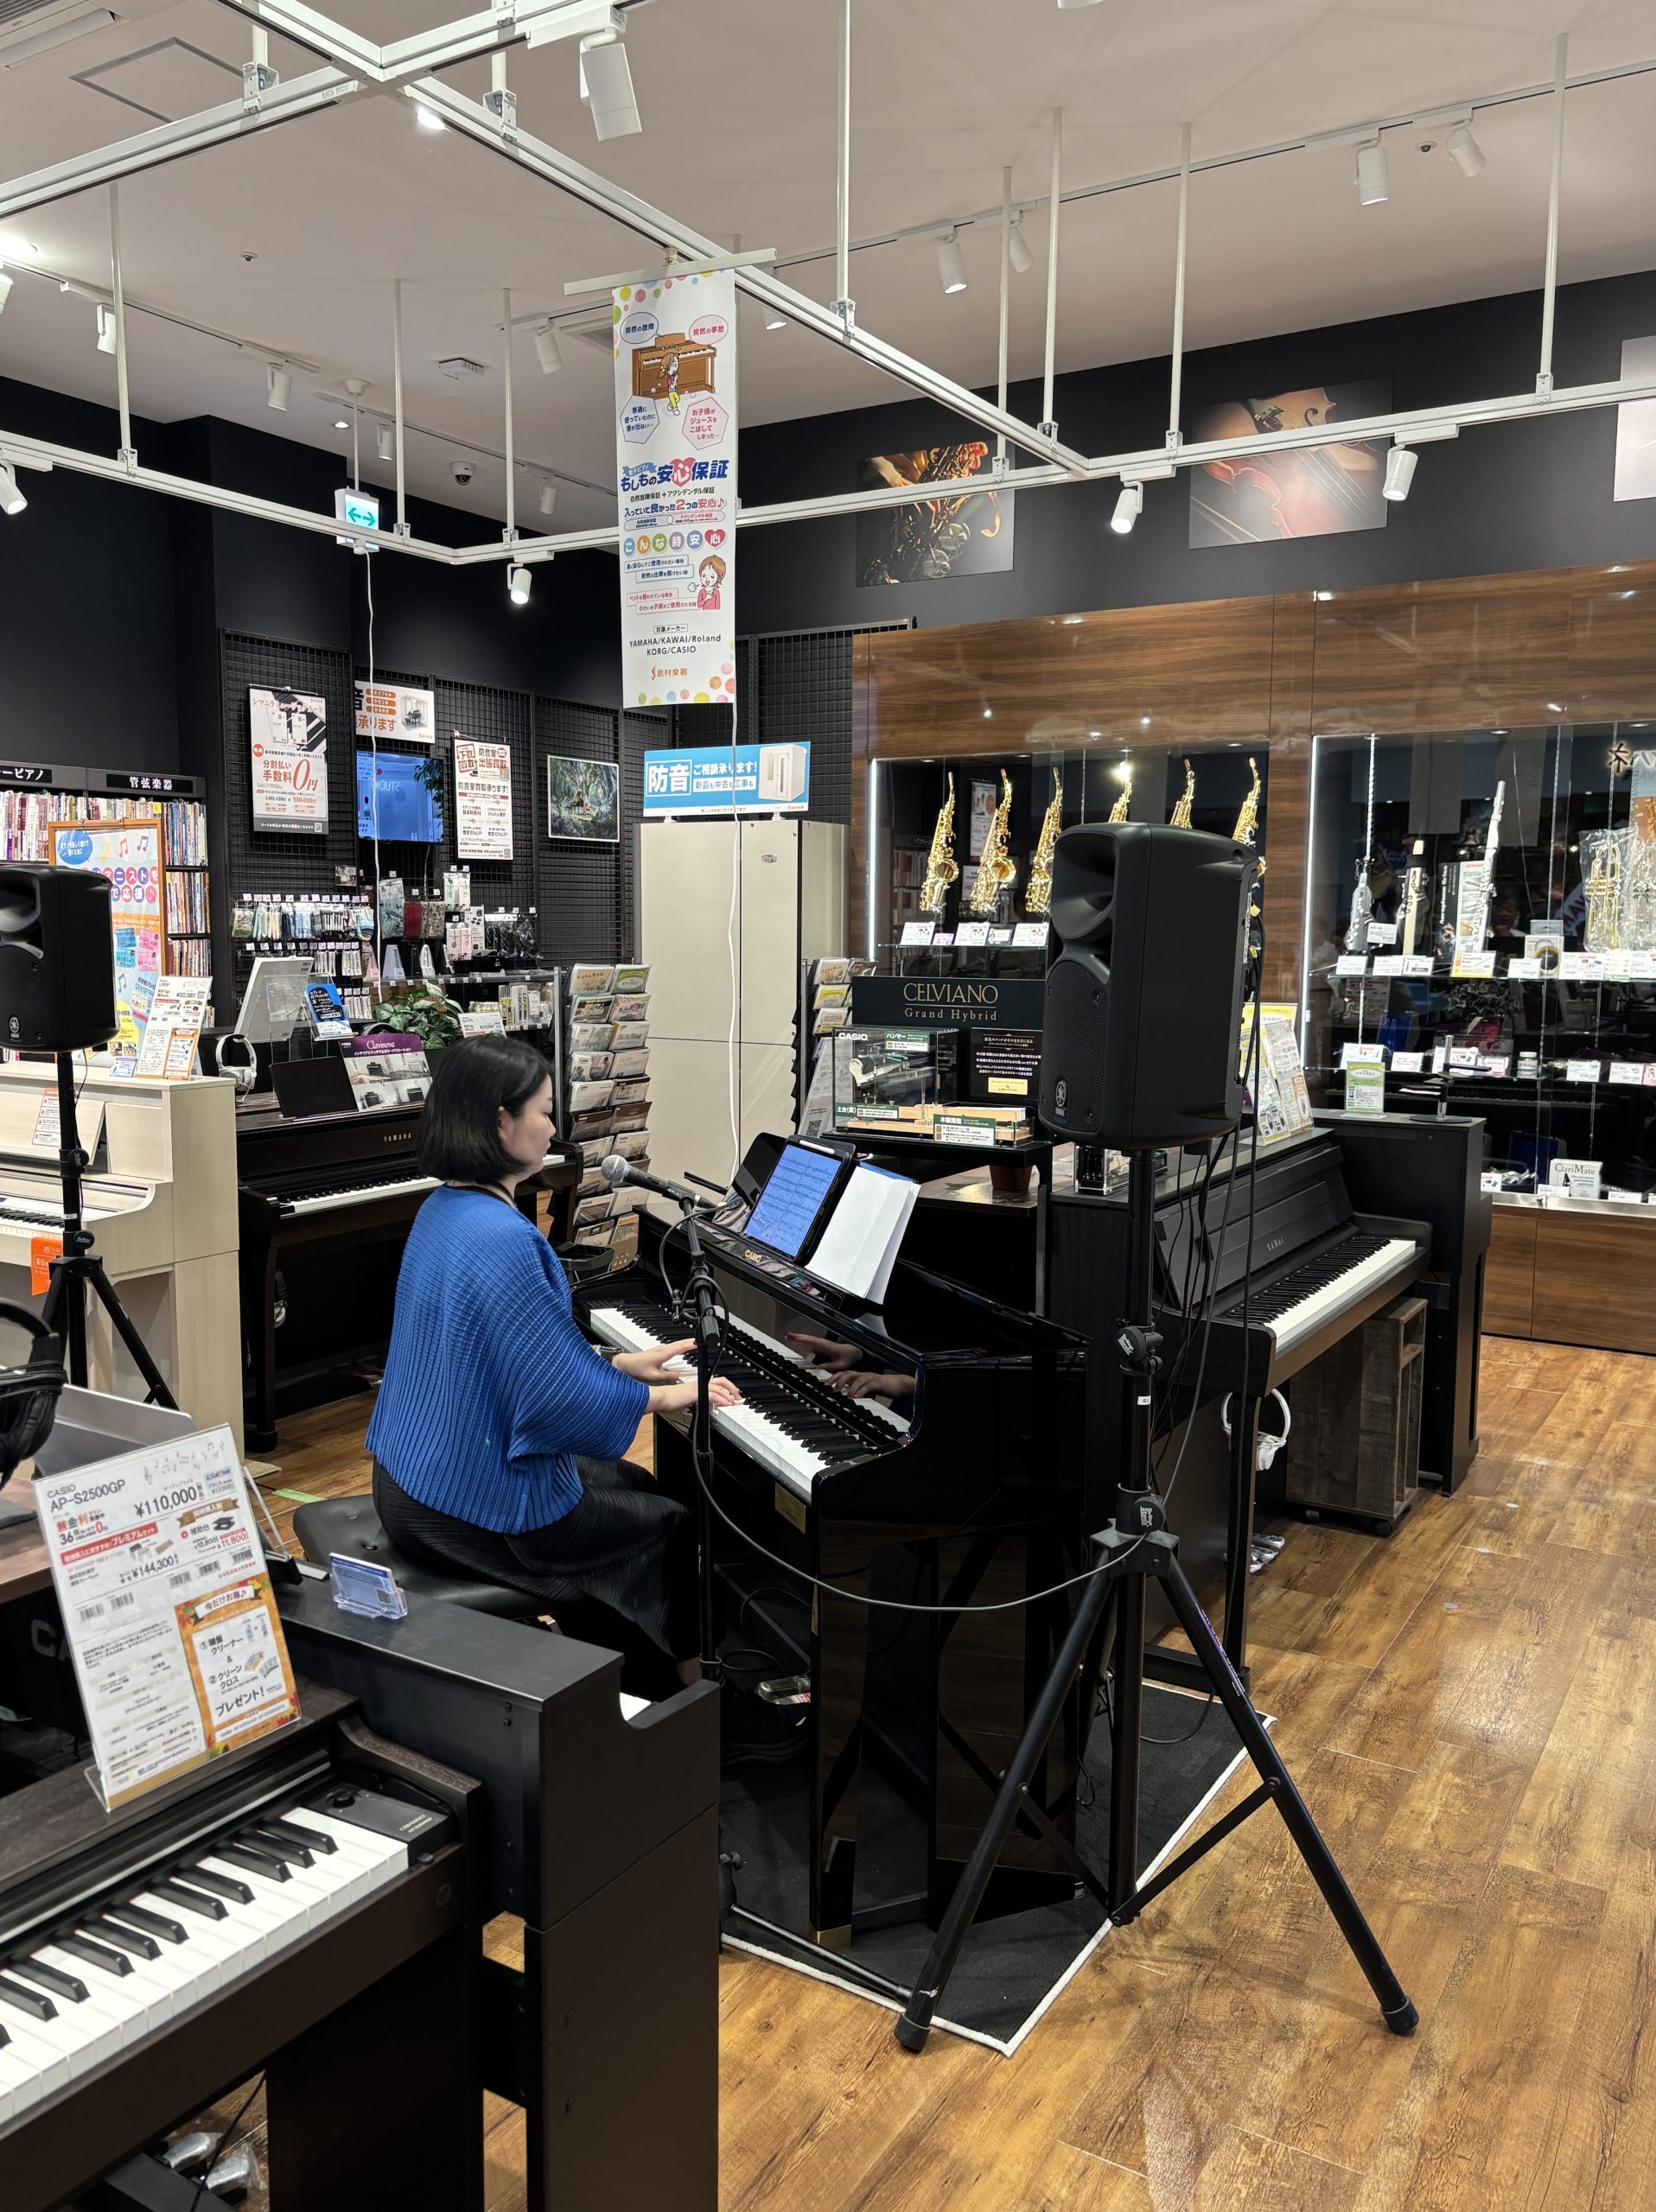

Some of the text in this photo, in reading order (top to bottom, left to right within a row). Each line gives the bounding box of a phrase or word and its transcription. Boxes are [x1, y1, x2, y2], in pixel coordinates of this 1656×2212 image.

[693, 326, 724, 336] 突然の事故
[624, 415, 656, 423] 使っていたのに
[691, 416, 717, 425] ジュースを
[621, 460, 729, 492] もしもの安心保証
[629, 634, 721, 648] YAMAHA/KAWAI/Roland
[646, 645, 697, 656] KORG/CASIO
[263, 760, 291, 769] 分割払い
[0, 767, 44, 780] ーピアノ
[263, 770, 292, 783] 手数料
[648, 763, 690, 793] 防音
[130, 776, 173, 791] 管弦楽器
[903, 982, 998, 1004] CELVIANO
[905, 1007, 997, 1021] Grand Hybrid
[838, 1032, 868, 1041] CASIO
[384, 1132, 411, 1142] YAMAHA
[1555, 1163, 1595, 1175] ClariMate
[745, 1249, 761, 1263] CASIO
[47, 1484, 76, 1498] CASIO
[50, 1479, 125, 1512] AP-S2500GP
[135, 1486, 197, 1517] ¥110,000
[190, 1524, 210, 1535] 補助台
[59, 1531, 74, 1545] 36
[211, 1638, 244, 1656] クリーナー
[218, 1665, 242, 1681] クリーン
[220, 1676, 240, 1689] クロス
[215, 1687, 264, 1717] プレゼント!
